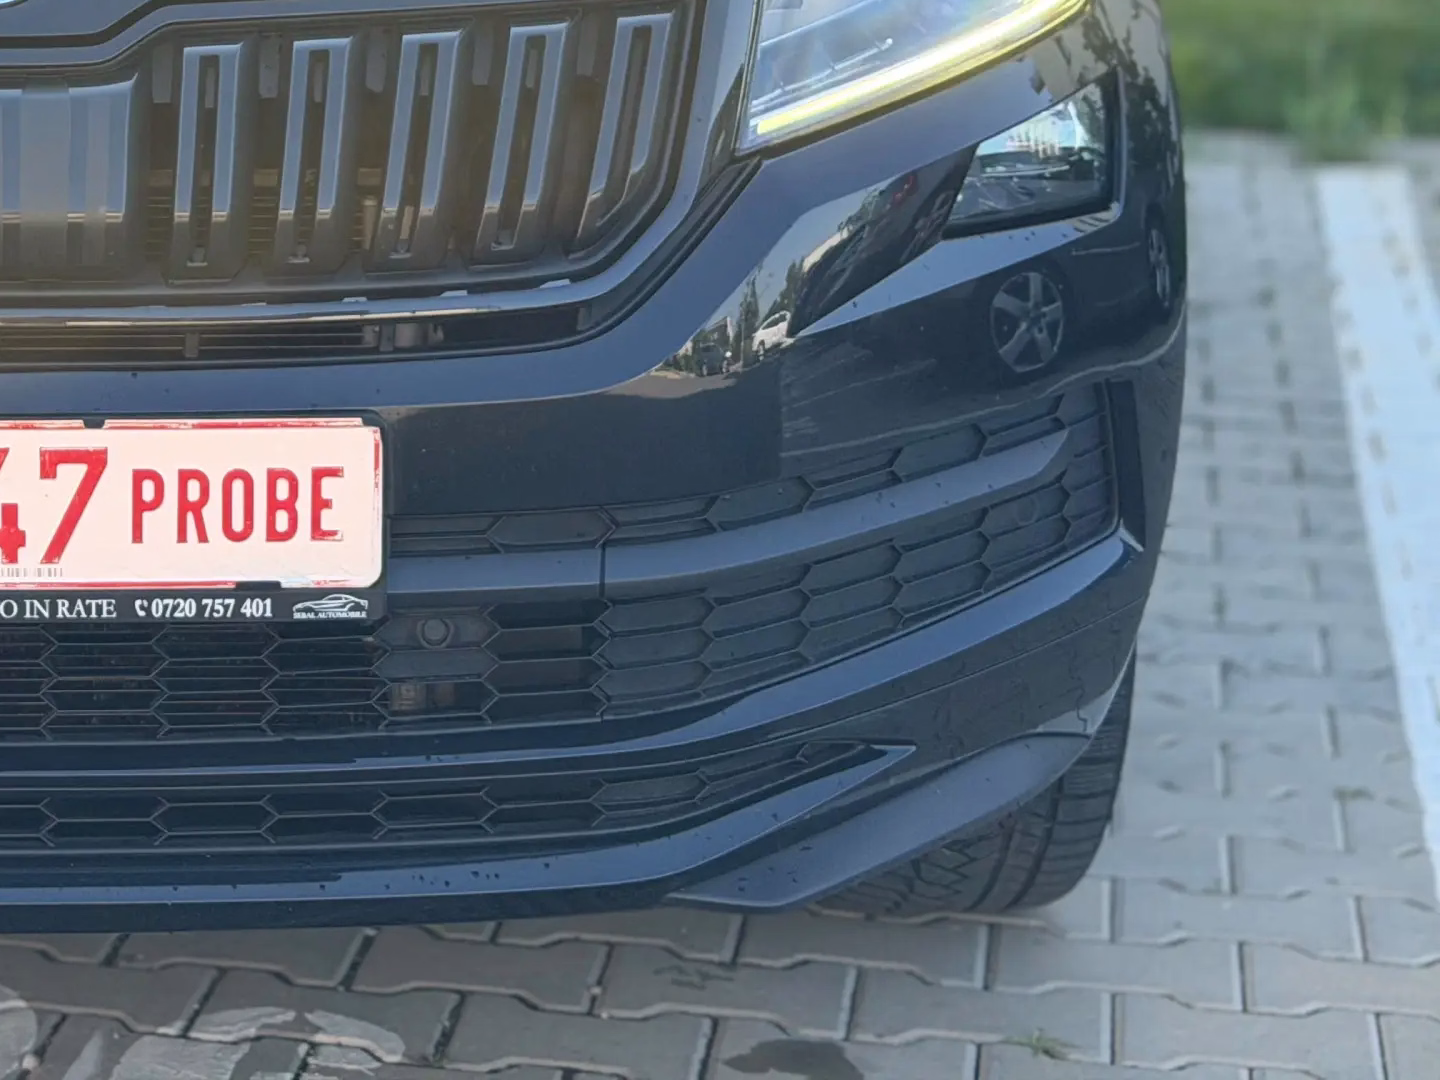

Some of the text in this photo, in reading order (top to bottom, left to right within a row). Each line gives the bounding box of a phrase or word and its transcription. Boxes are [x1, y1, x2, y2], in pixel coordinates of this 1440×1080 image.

[131, 465, 344, 544] PROBE
[23, 599, 50, 618] IN
[56, 598, 117, 618] RATE
[151, 597, 197, 618] 0720
[201, 598, 236, 618] 757
[240, 597, 273, 618] 401
